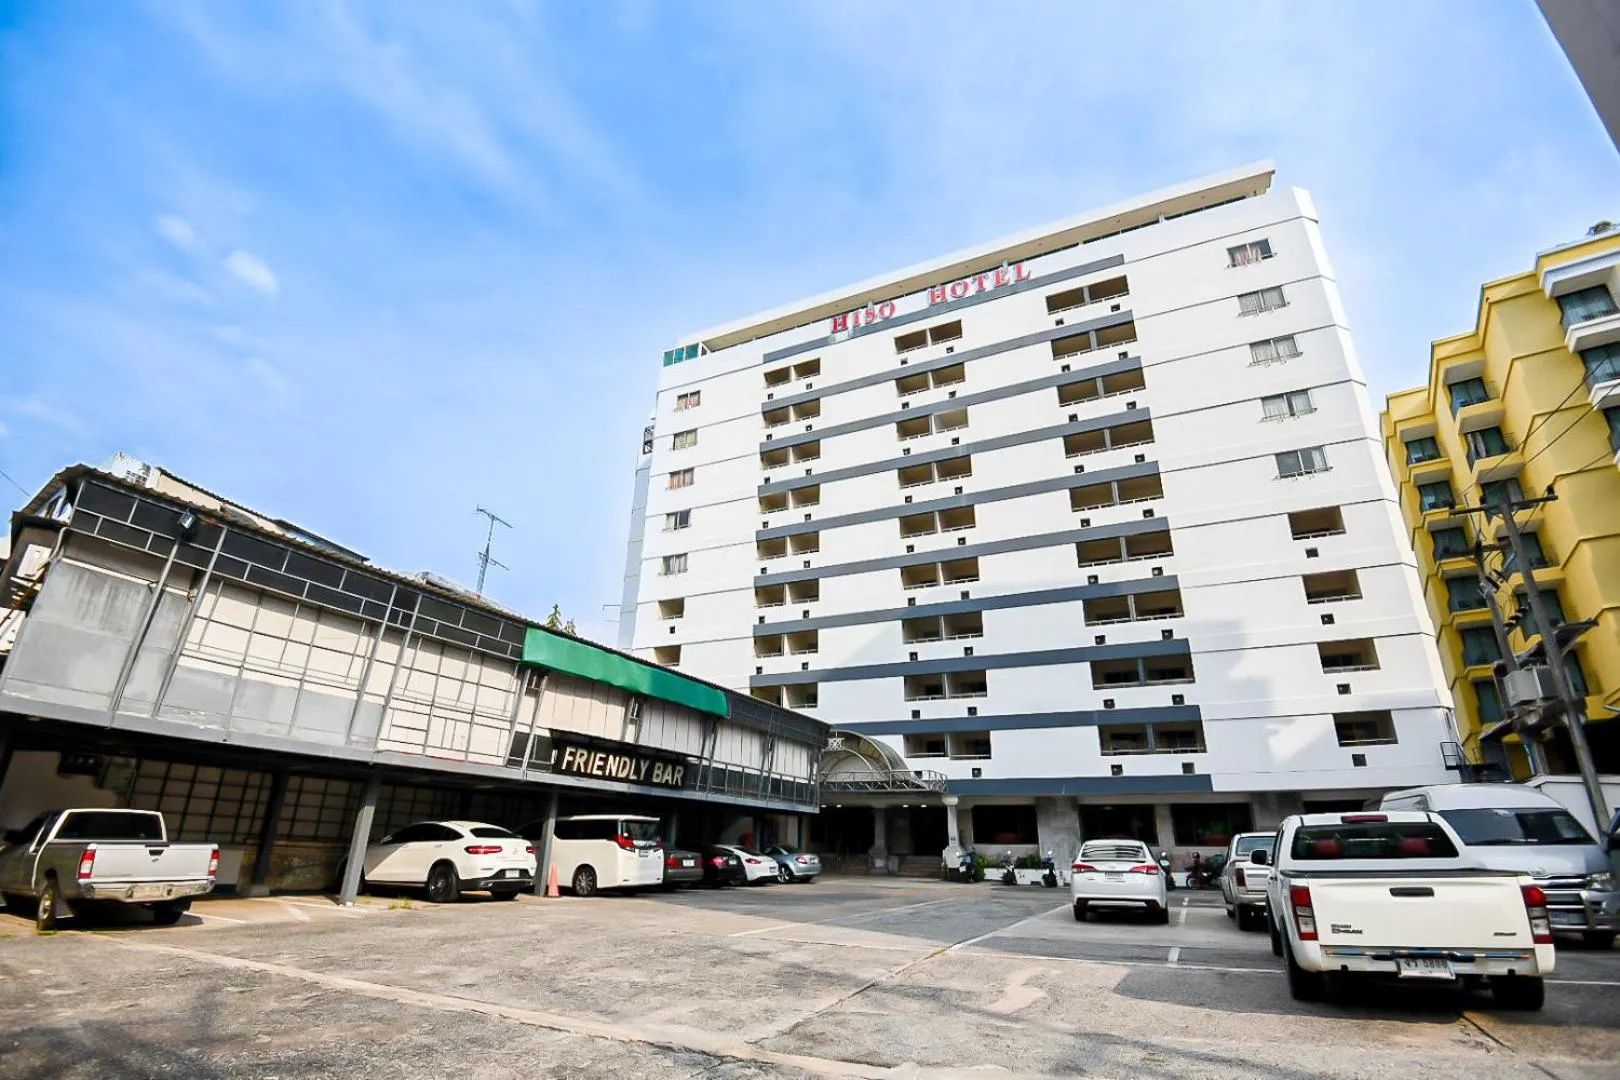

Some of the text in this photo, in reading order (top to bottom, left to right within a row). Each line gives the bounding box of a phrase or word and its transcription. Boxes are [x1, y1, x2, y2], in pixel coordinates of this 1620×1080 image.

[832, 262, 1031, 334] HISO HOTEL
[561, 746, 684, 786] FRIENDLY BAR
